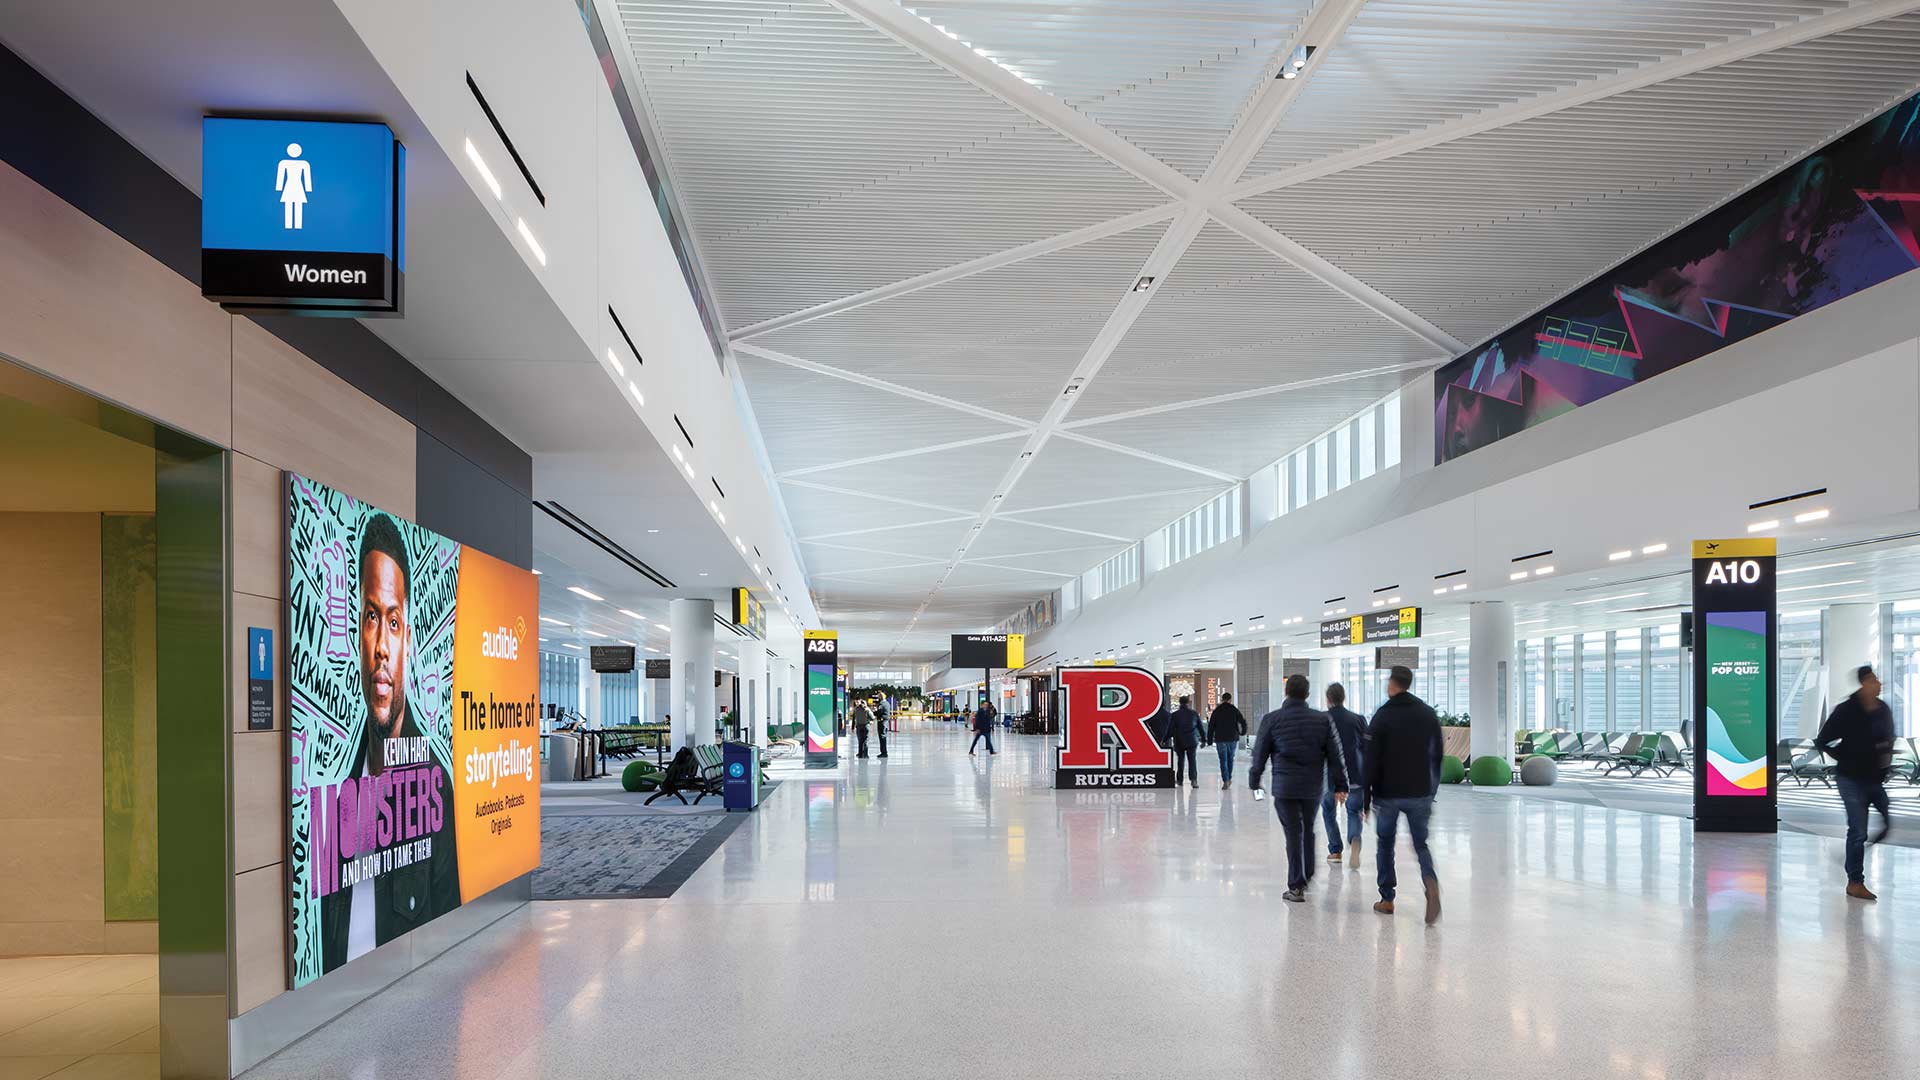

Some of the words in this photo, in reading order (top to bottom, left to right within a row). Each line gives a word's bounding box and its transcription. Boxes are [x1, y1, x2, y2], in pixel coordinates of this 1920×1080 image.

[284, 263, 367, 284] Women
[1705, 560, 1761, 585] A10
[482, 626, 518, 661] audible
[807, 640, 835, 653] A26
[1711, 666, 1733, 675] POP
[1734, 666, 1760, 676] QUIZ
[461, 691, 486, 731] The
[490, 692, 523, 729] home
[525, 693, 535, 728] of
[1056, 666, 1174, 769] R
[318, 727, 334, 750] NOT
[384, 738, 409, 767] KEVIN
[410, 736, 431, 763] HART
[465, 739, 533, 789] storytelling
[1075, 773, 1157, 786] RUTGERS
[310, 764, 444, 900] MONSTERS
[342, 860, 360, 889] AND
[362, 853, 381, 881] HOW
[383, 848, 392, 873] TO
[394, 843, 413, 870] TAME
[414, 837, 432, 863] THEM
